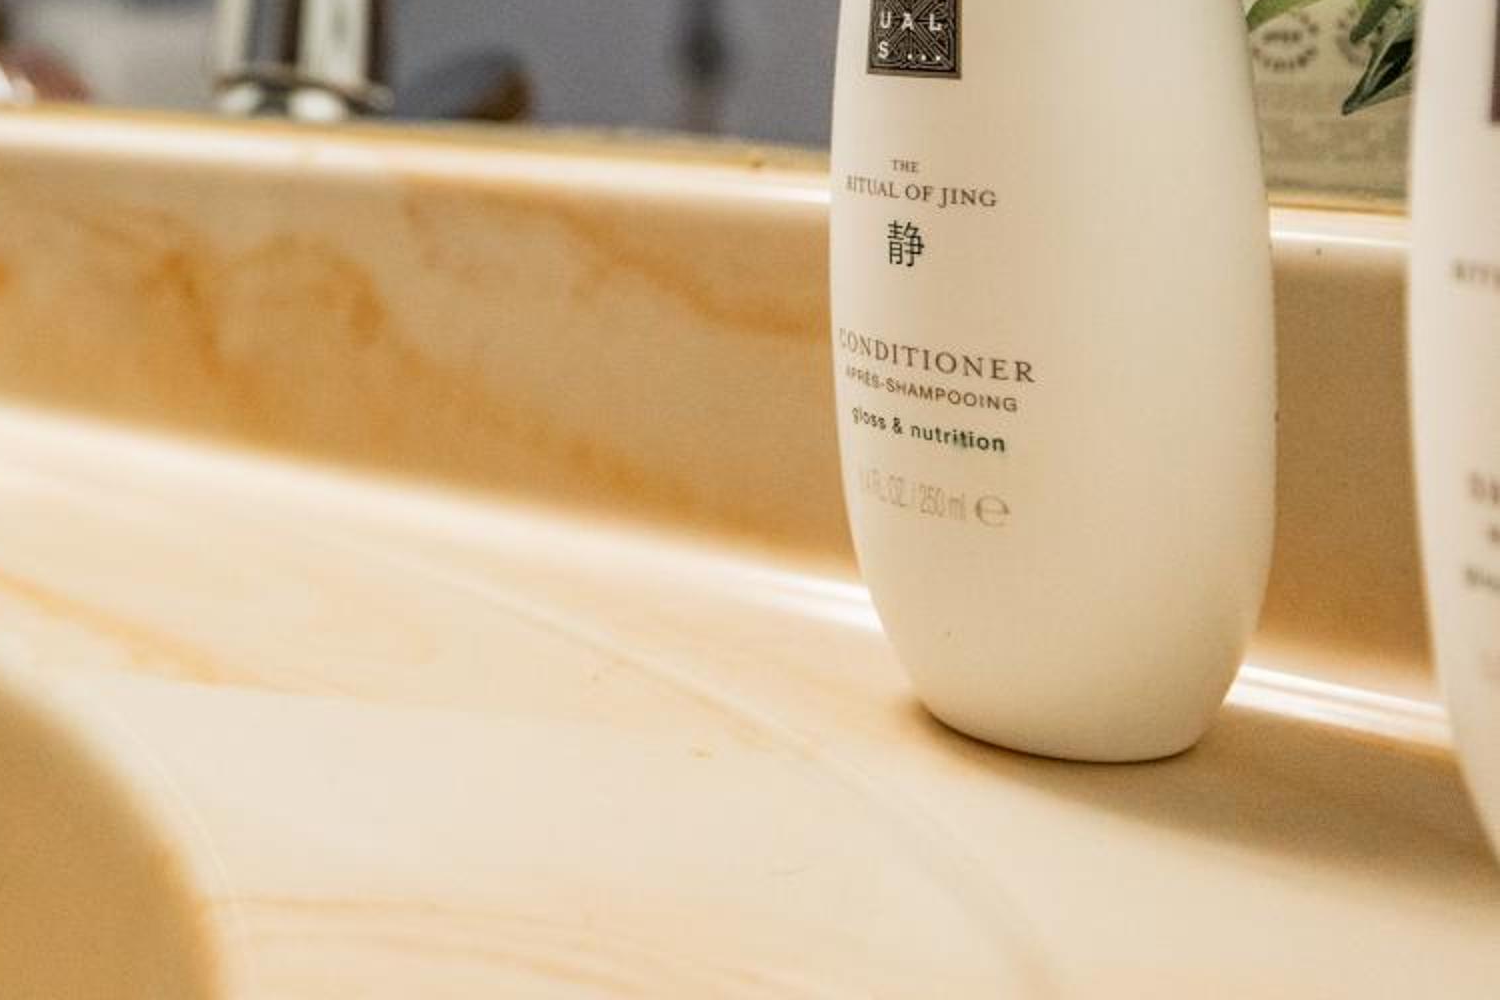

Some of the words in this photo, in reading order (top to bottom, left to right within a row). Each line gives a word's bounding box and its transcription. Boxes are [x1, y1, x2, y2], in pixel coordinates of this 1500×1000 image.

[891, 158, 919, 174] THE
[904, 183, 933, 201] OF
[937, 186, 998, 209] JING
[887, 219, 925, 267] 静
[840, 327, 1036, 384] CONDITIONER
[851, 404, 887, 431] gloss
[891, 416, 904, 435] &
[910, 424, 1006, 453] nutrition
